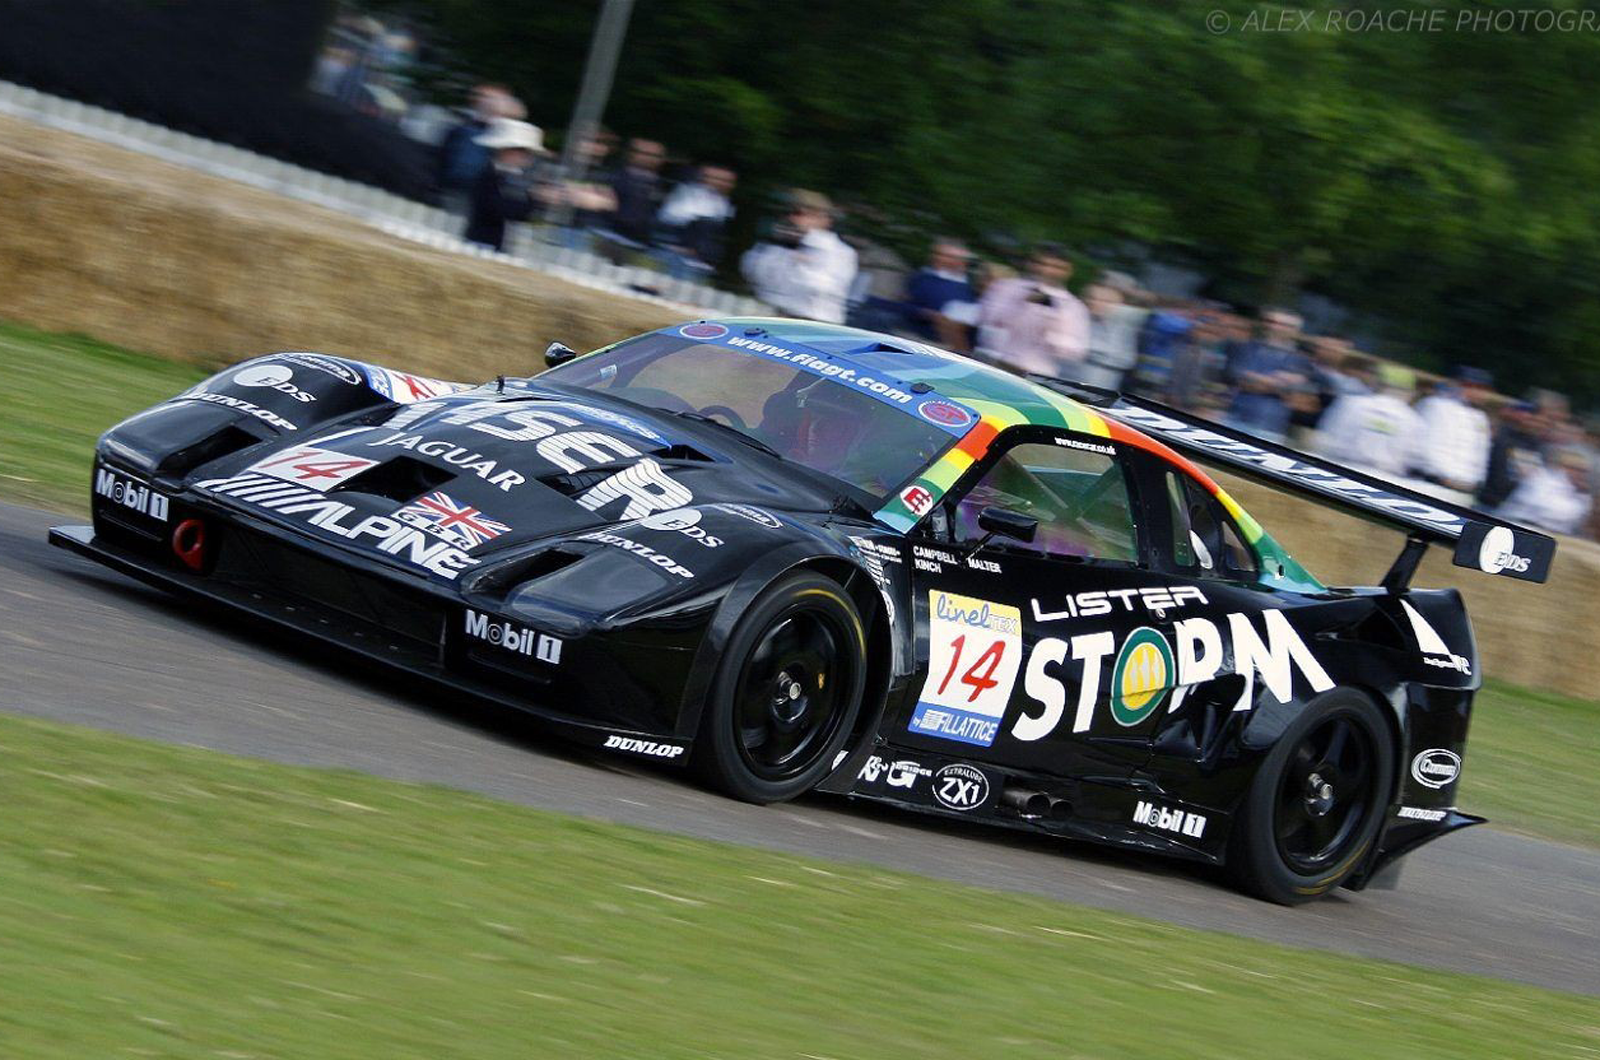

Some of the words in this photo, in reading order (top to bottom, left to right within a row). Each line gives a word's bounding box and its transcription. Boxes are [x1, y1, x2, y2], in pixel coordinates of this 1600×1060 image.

[727, 336, 914, 404] www.fiagt.com
[257, 376, 317, 403] EDS
[190, 391, 298, 431] DUNLOP
[260, 451, 371, 481] 14
[367, 433, 526, 492] JAGUAR
[1105, 401, 1467, 533] DUNLO
[96, 468, 149, 514] Mobil
[151, 494, 169, 522] 1
[277, 494, 481, 579] ALPINE
[663, 518, 725, 549] EDS
[577, 531, 695, 580] DUNLOP
[912, 545, 958, 566] CAMPBELL
[914, 558, 942, 574] KINCH
[1494, 552, 1533, 575] EDS
[1030, 585, 1209, 622] LISTER
[465, 609, 533, 657] Mobil
[536, 634, 563, 665] 1
[937, 634, 1006, 703] 14
[937, 712, 998, 742] FILLATTICE
[603, 734, 684, 758] DUNLOP
[939, 776, 980, 805] ZX1
[1133, 801, 1183, 833] Mobil
[1184, 811, 1207, 838] 1
